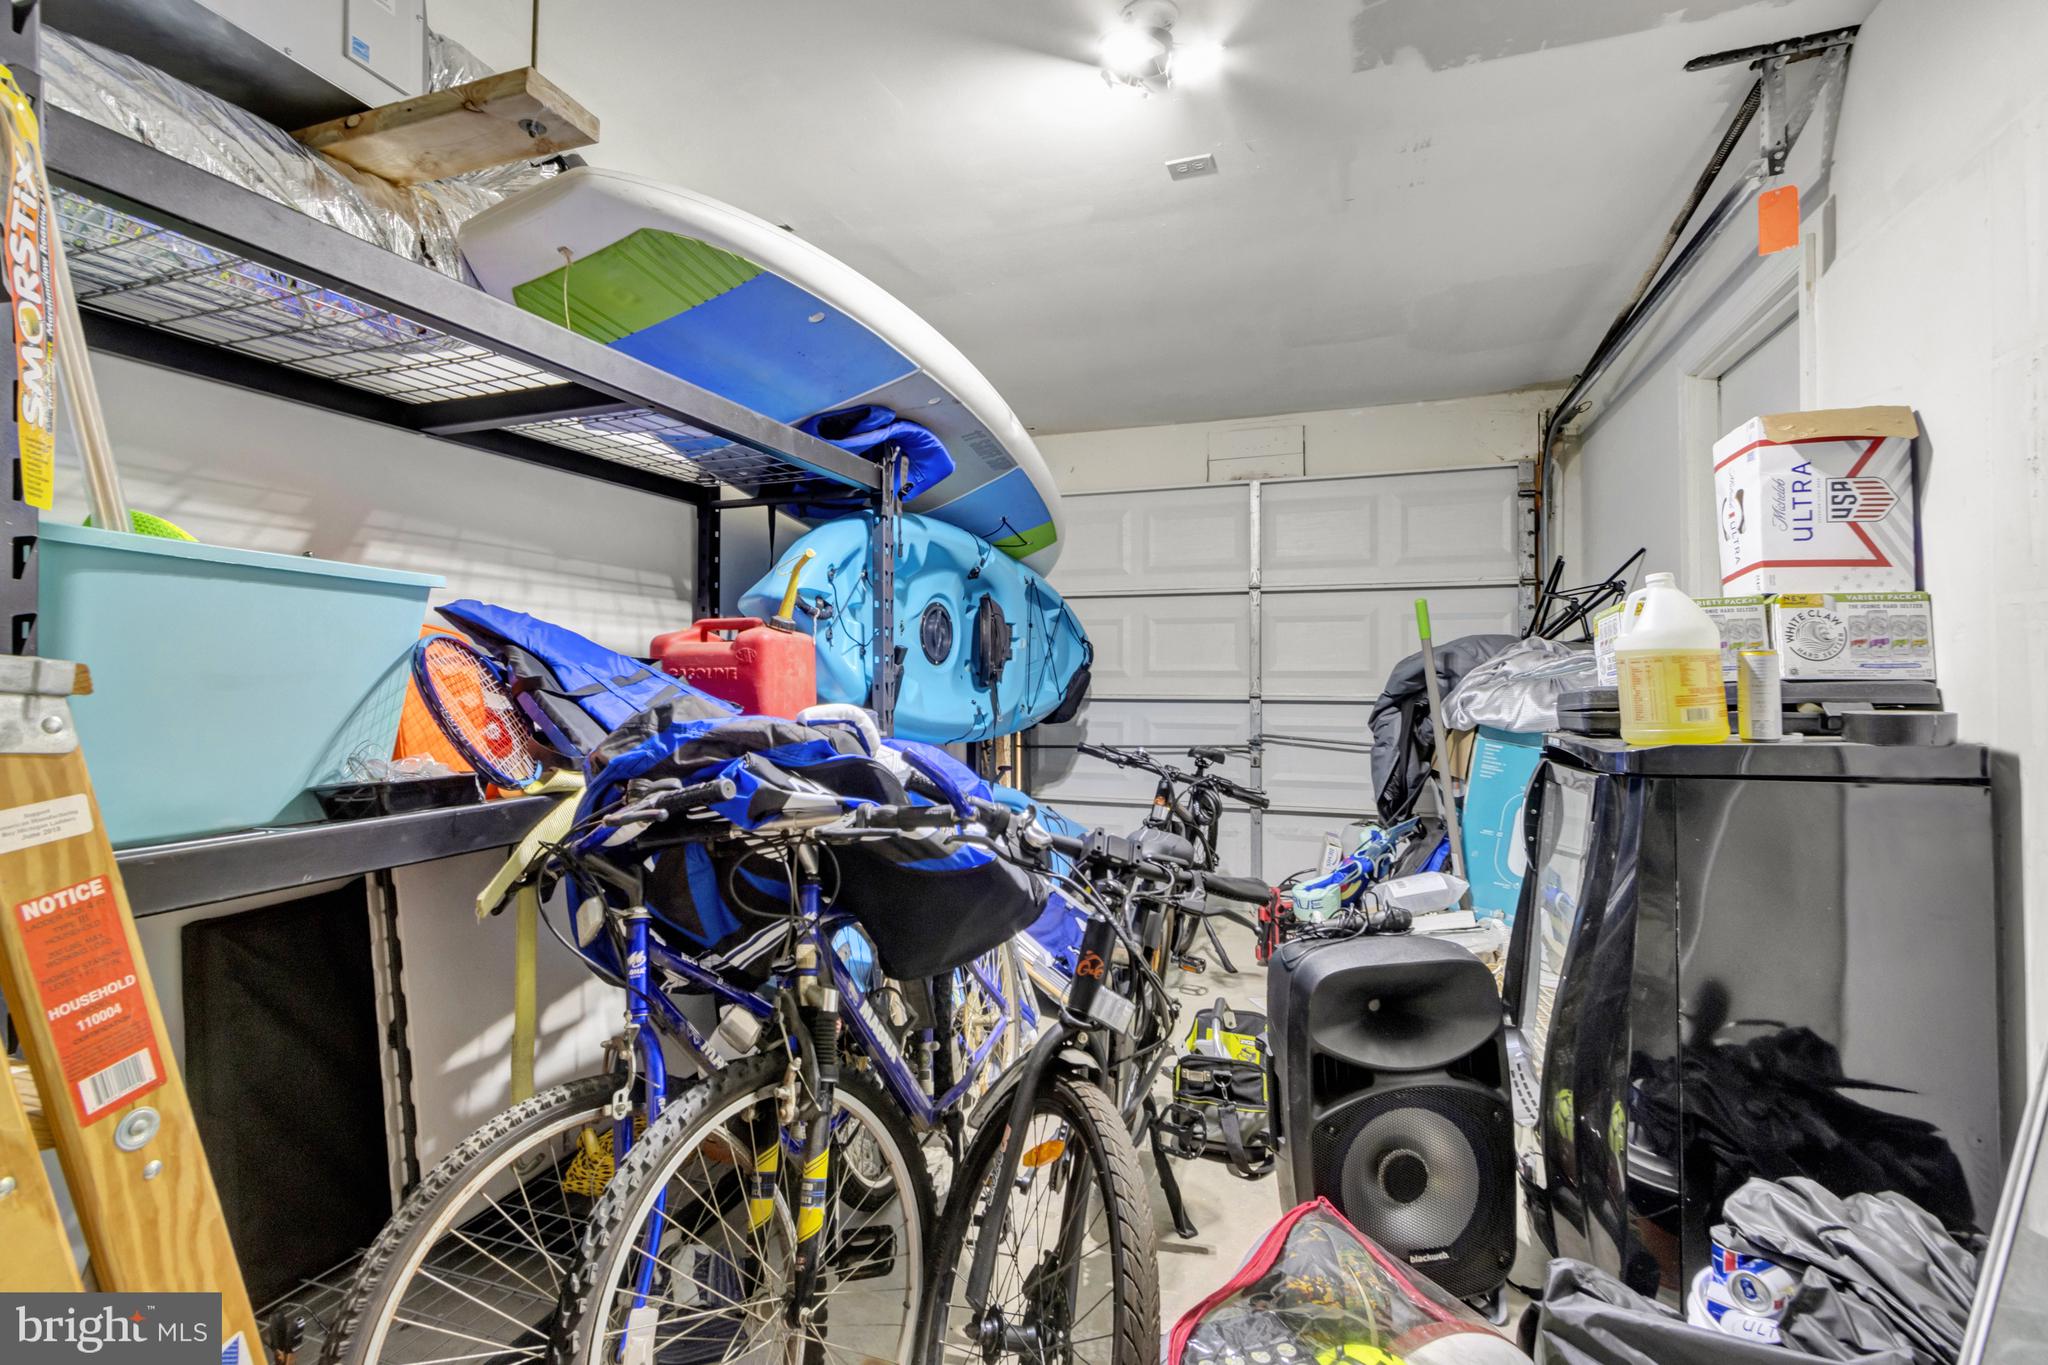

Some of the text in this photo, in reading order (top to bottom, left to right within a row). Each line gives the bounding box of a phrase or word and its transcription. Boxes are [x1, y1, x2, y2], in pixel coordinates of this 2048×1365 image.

[1772, 477, 1789, 532] Michelob
[1791, 461, 1814, 541] ULTRA
[1831, 481, 1857, 519] USA
[1846, 593, 1883, 601] VARIETY
[1785, 609, 1843, 643] WHITE CLAW
[20, 878, 107, 922] NOTICE
[48, 974, 137, 1022] HOUSEHOLD
[76, 1003, 123, 1032] 110004
